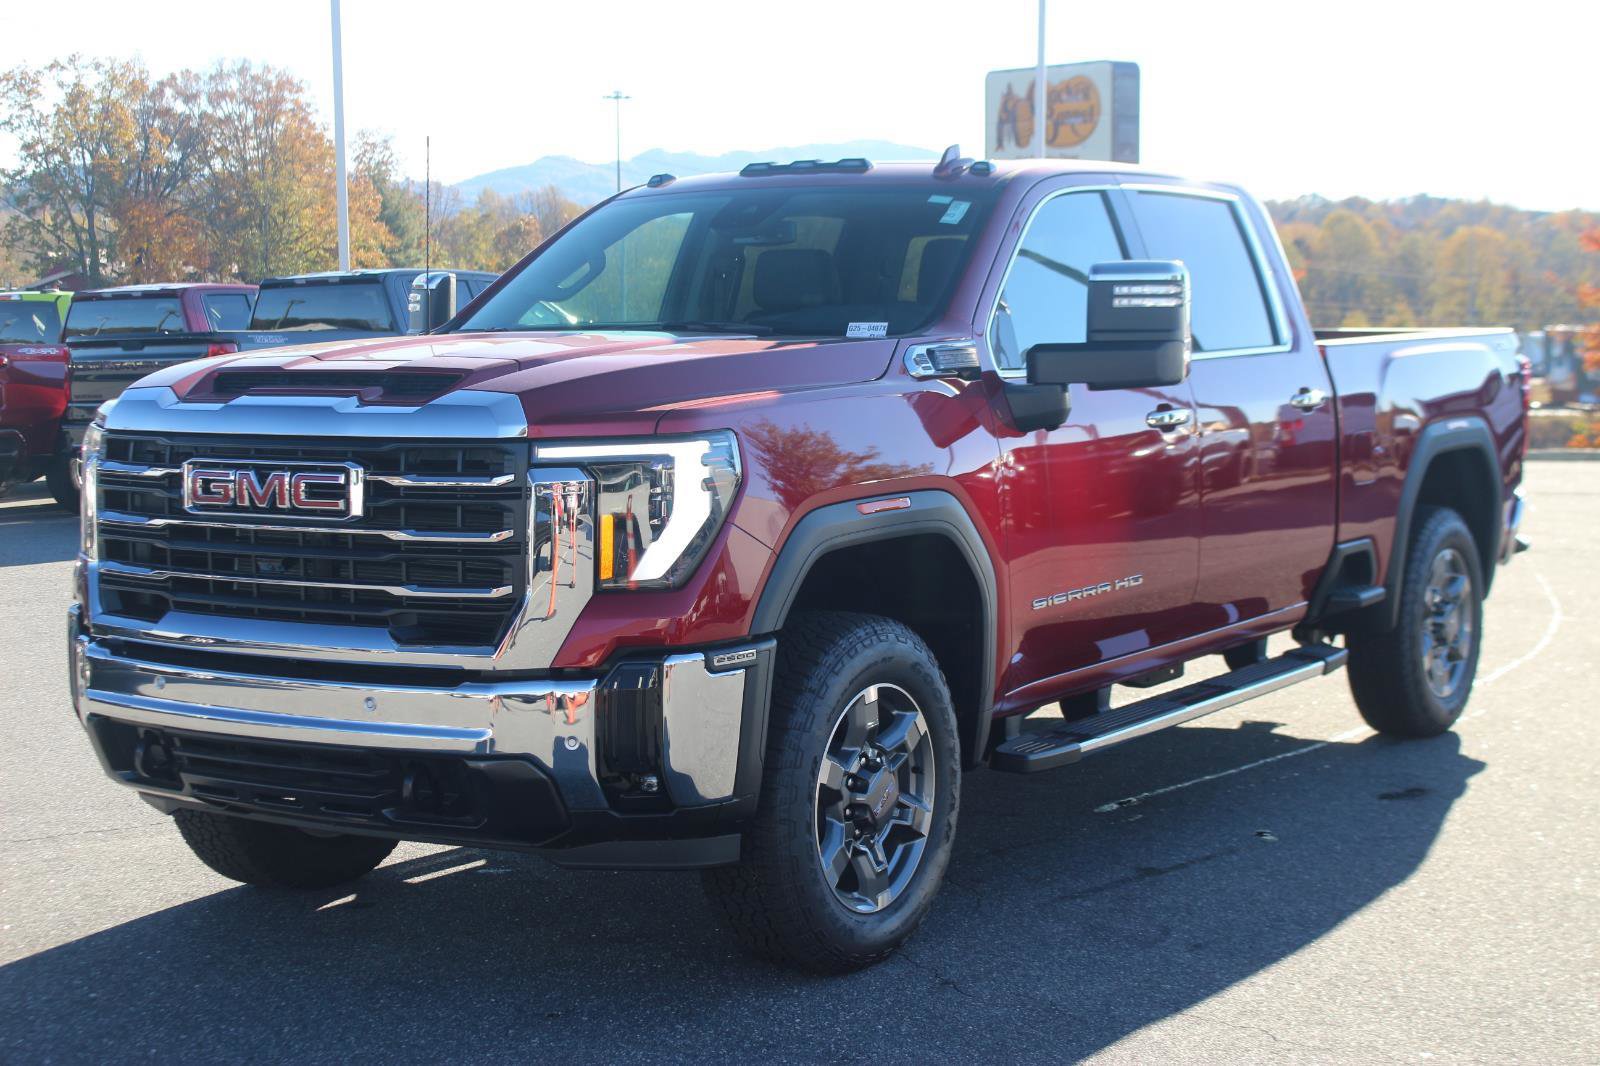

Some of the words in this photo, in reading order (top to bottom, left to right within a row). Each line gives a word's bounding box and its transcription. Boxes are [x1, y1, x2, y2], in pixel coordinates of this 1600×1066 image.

[191, 469, 345, 510] GMC
[1032, 582, 1112, 610] SIERRA
[1114, 574, 1144, 591] HD
[715, 651, 755, 664] 2500
